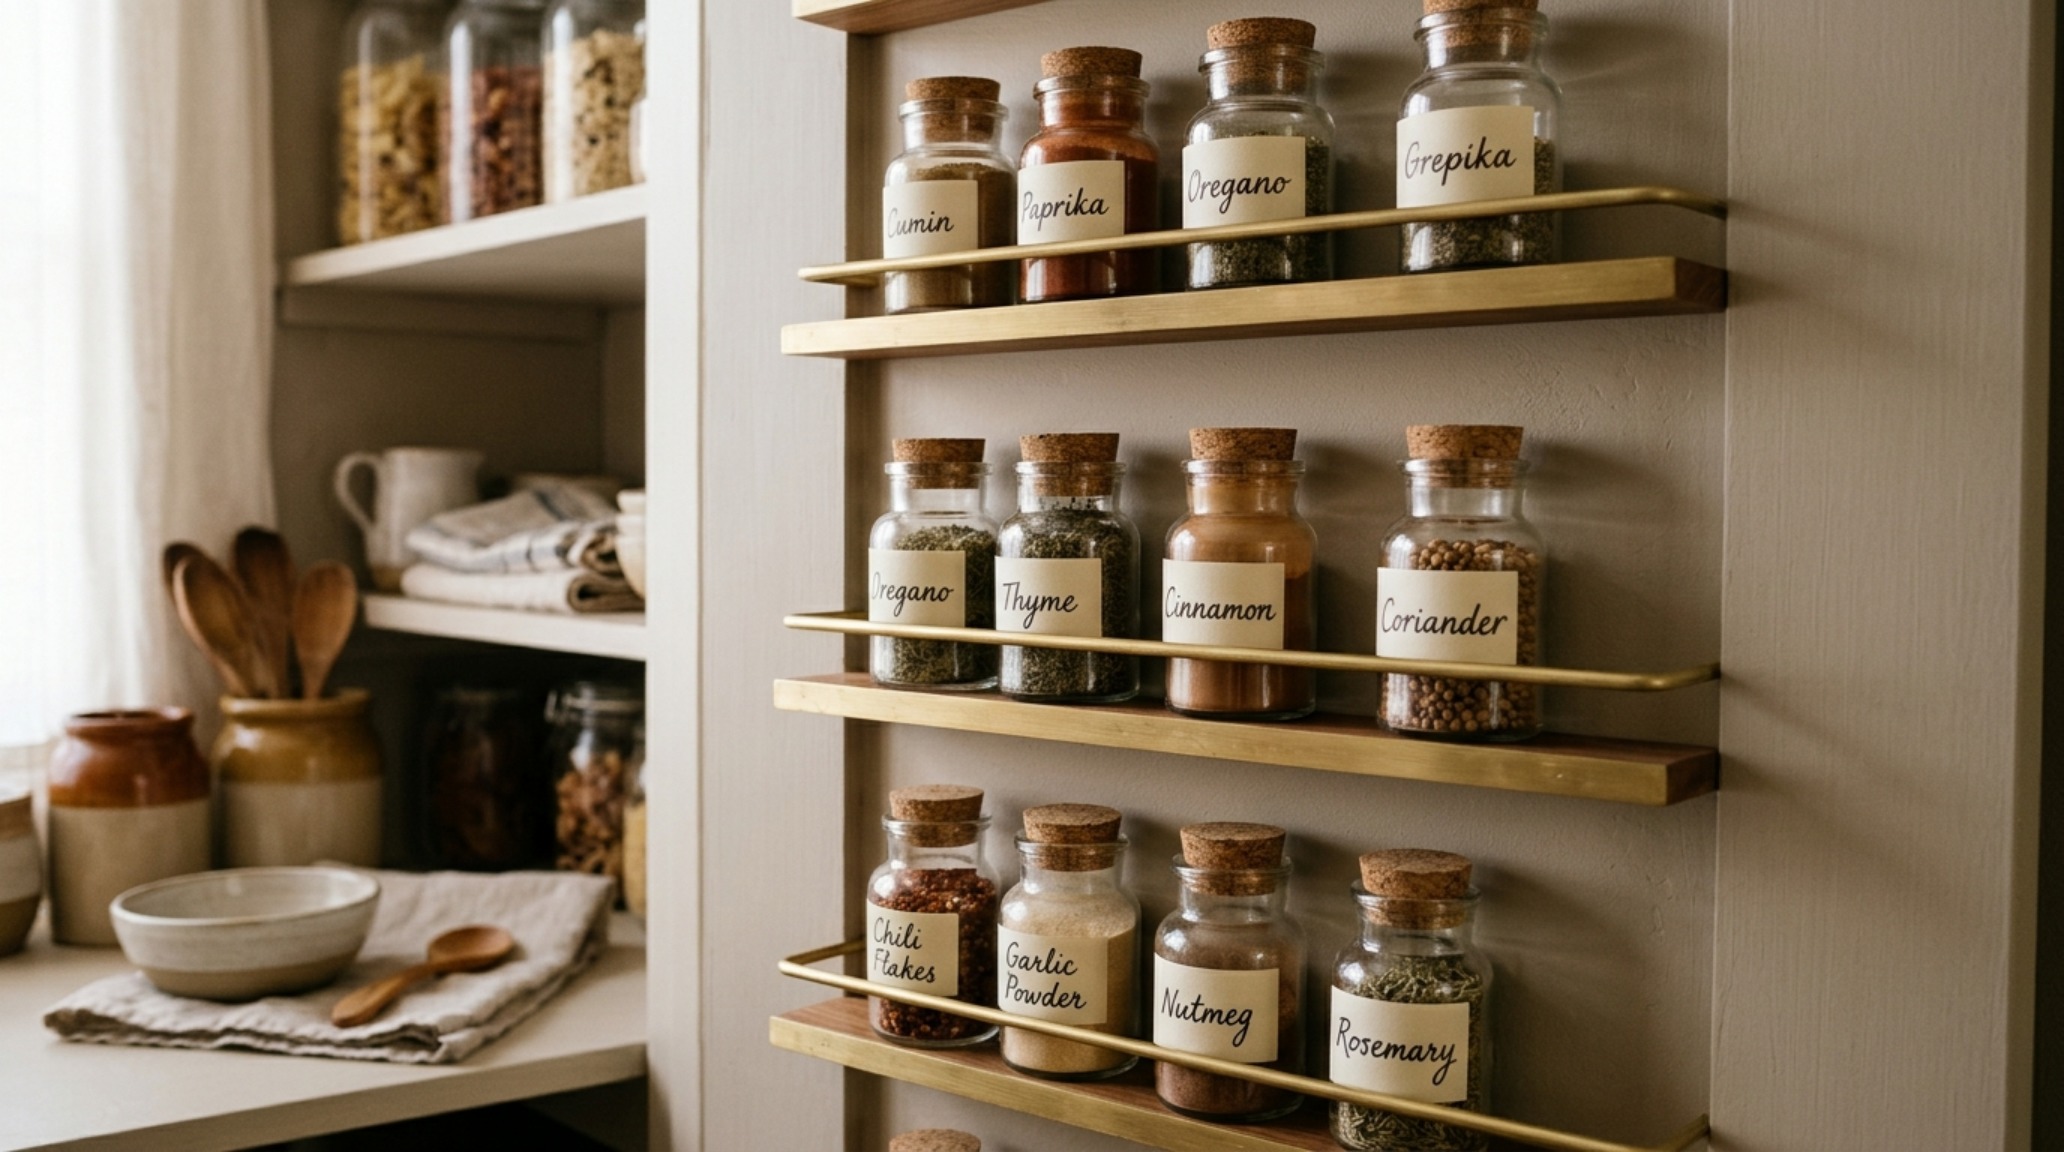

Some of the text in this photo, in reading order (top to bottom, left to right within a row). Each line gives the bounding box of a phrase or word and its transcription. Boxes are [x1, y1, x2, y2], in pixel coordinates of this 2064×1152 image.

[1405, 136, 1517, 187] Grepika
[1022, 187, 1110, 231] Paprika
[1187, 170, 1291, 214] Oregano
[887, 207, 954, 238] Cumin
[872, 571, 954, 617] Oregano
[1003, 582, 1078, 629] Thyme
[1165, 586, 1276, 622] Cinnamon
[1381, 597, 1508, 636] Coriander
[874, 917, 922, 950] Chili
[1006, 942, 1078, 976] Garlic
[1005, 972, 1087, 1010] Powder
[1161, 987, 1253, 1047] Nutmeg
[1336, 1017, 1457, 1086] Rosemary
